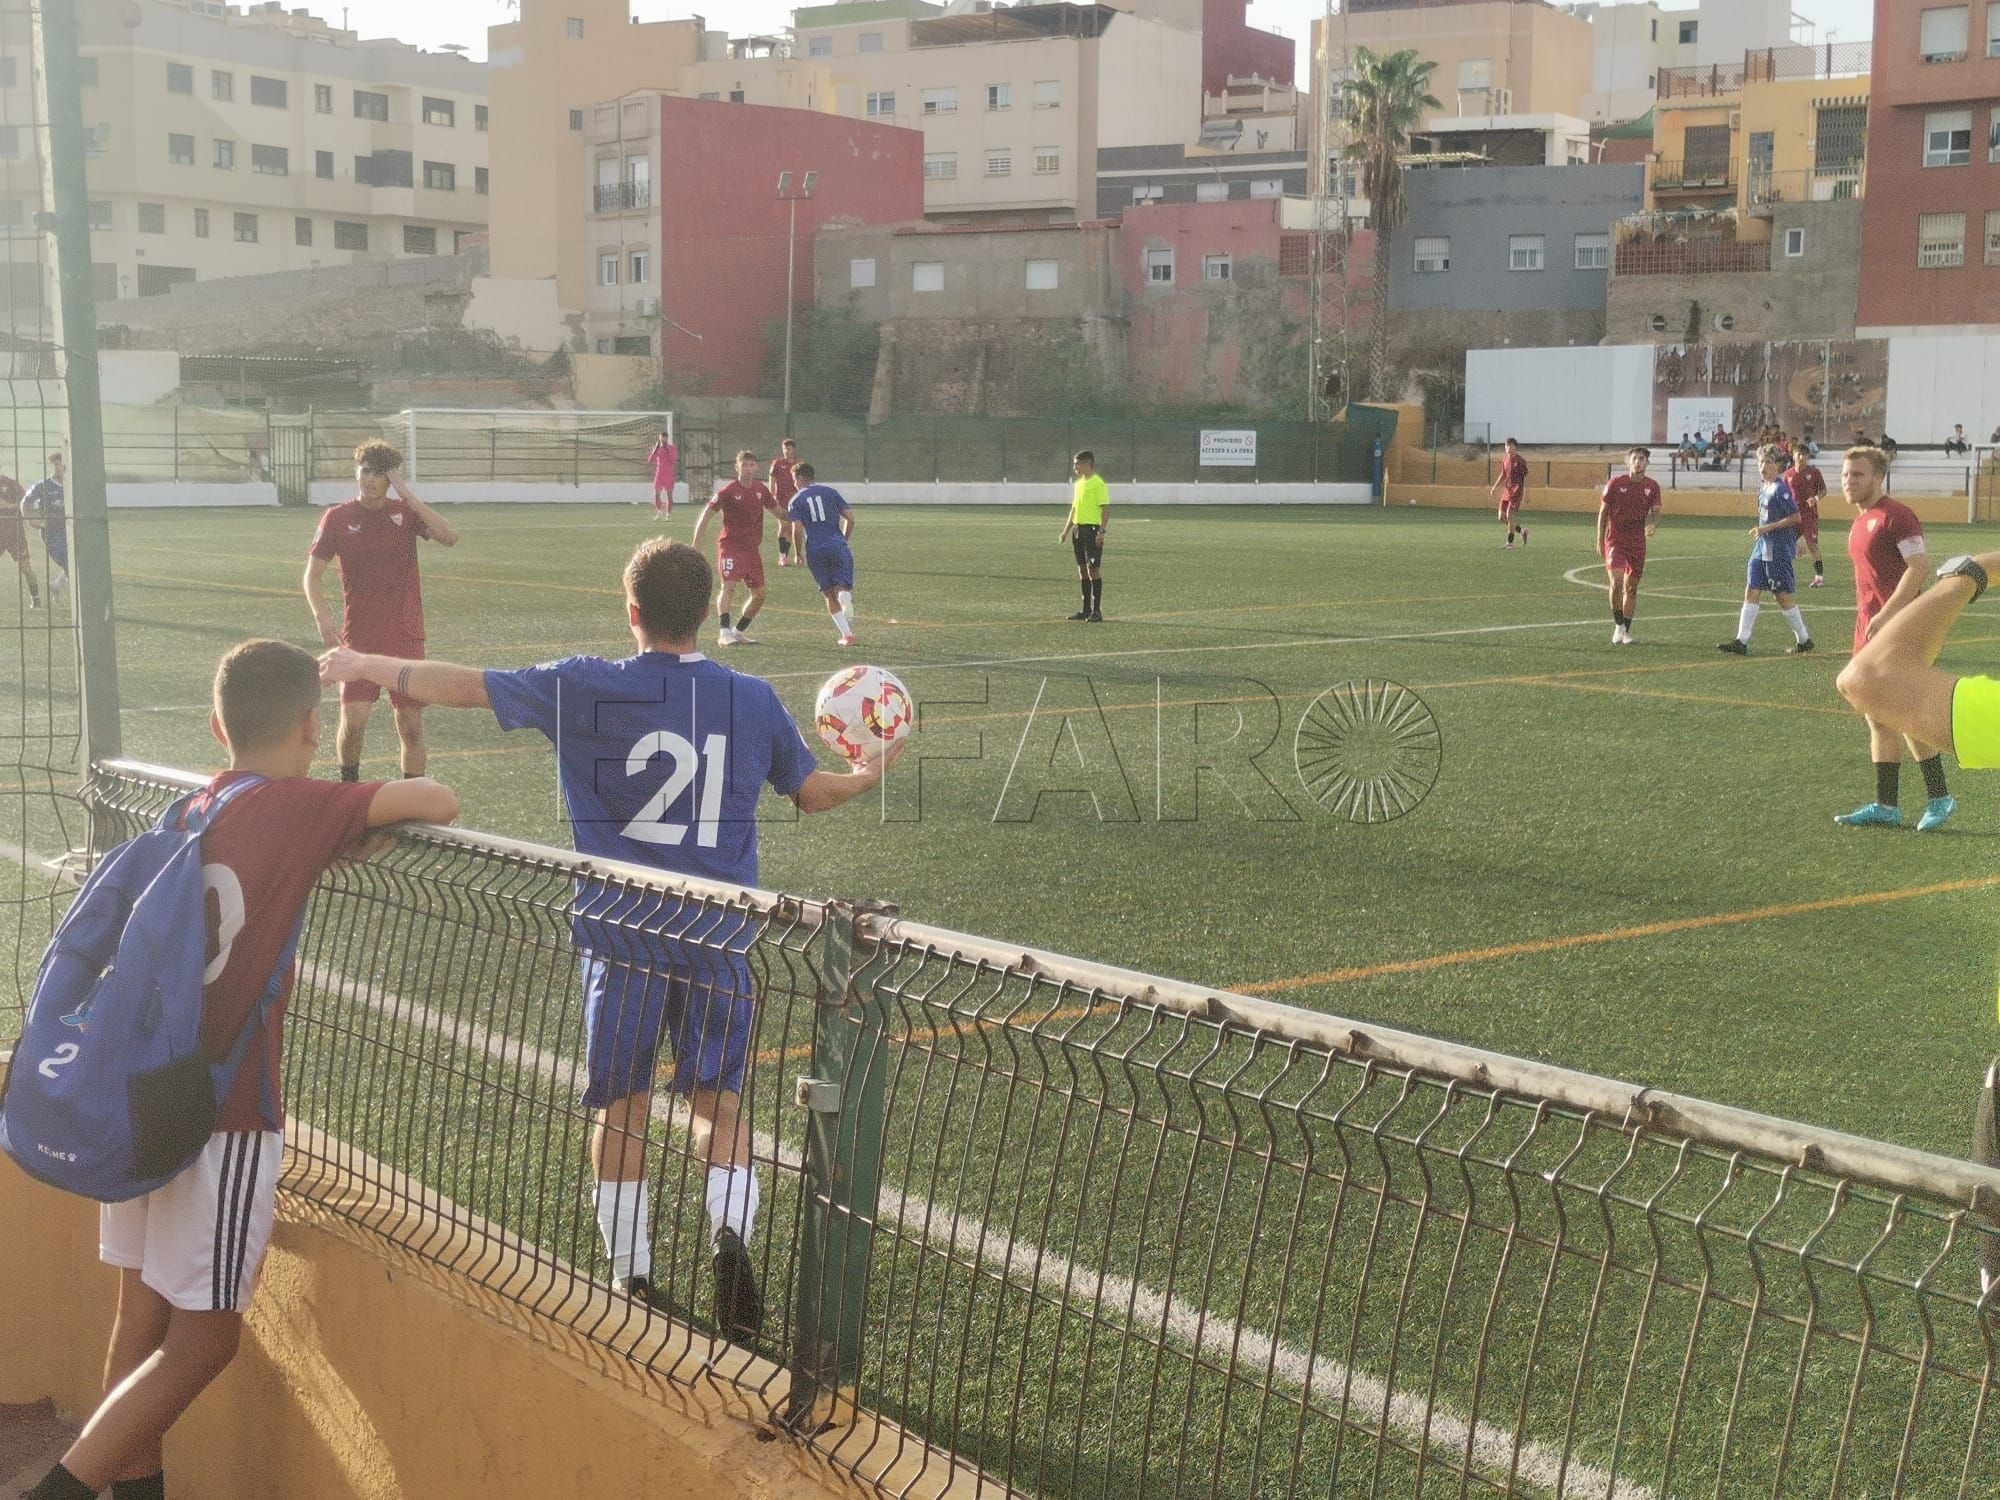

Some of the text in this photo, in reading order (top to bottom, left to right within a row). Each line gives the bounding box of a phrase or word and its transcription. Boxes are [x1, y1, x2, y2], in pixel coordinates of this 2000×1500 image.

[806, 495, 826, 522] 11
[721, 558, 734, 571] 15
[619, 730, 727, 848] 21
[38, 1042, 80, 1079] 2
